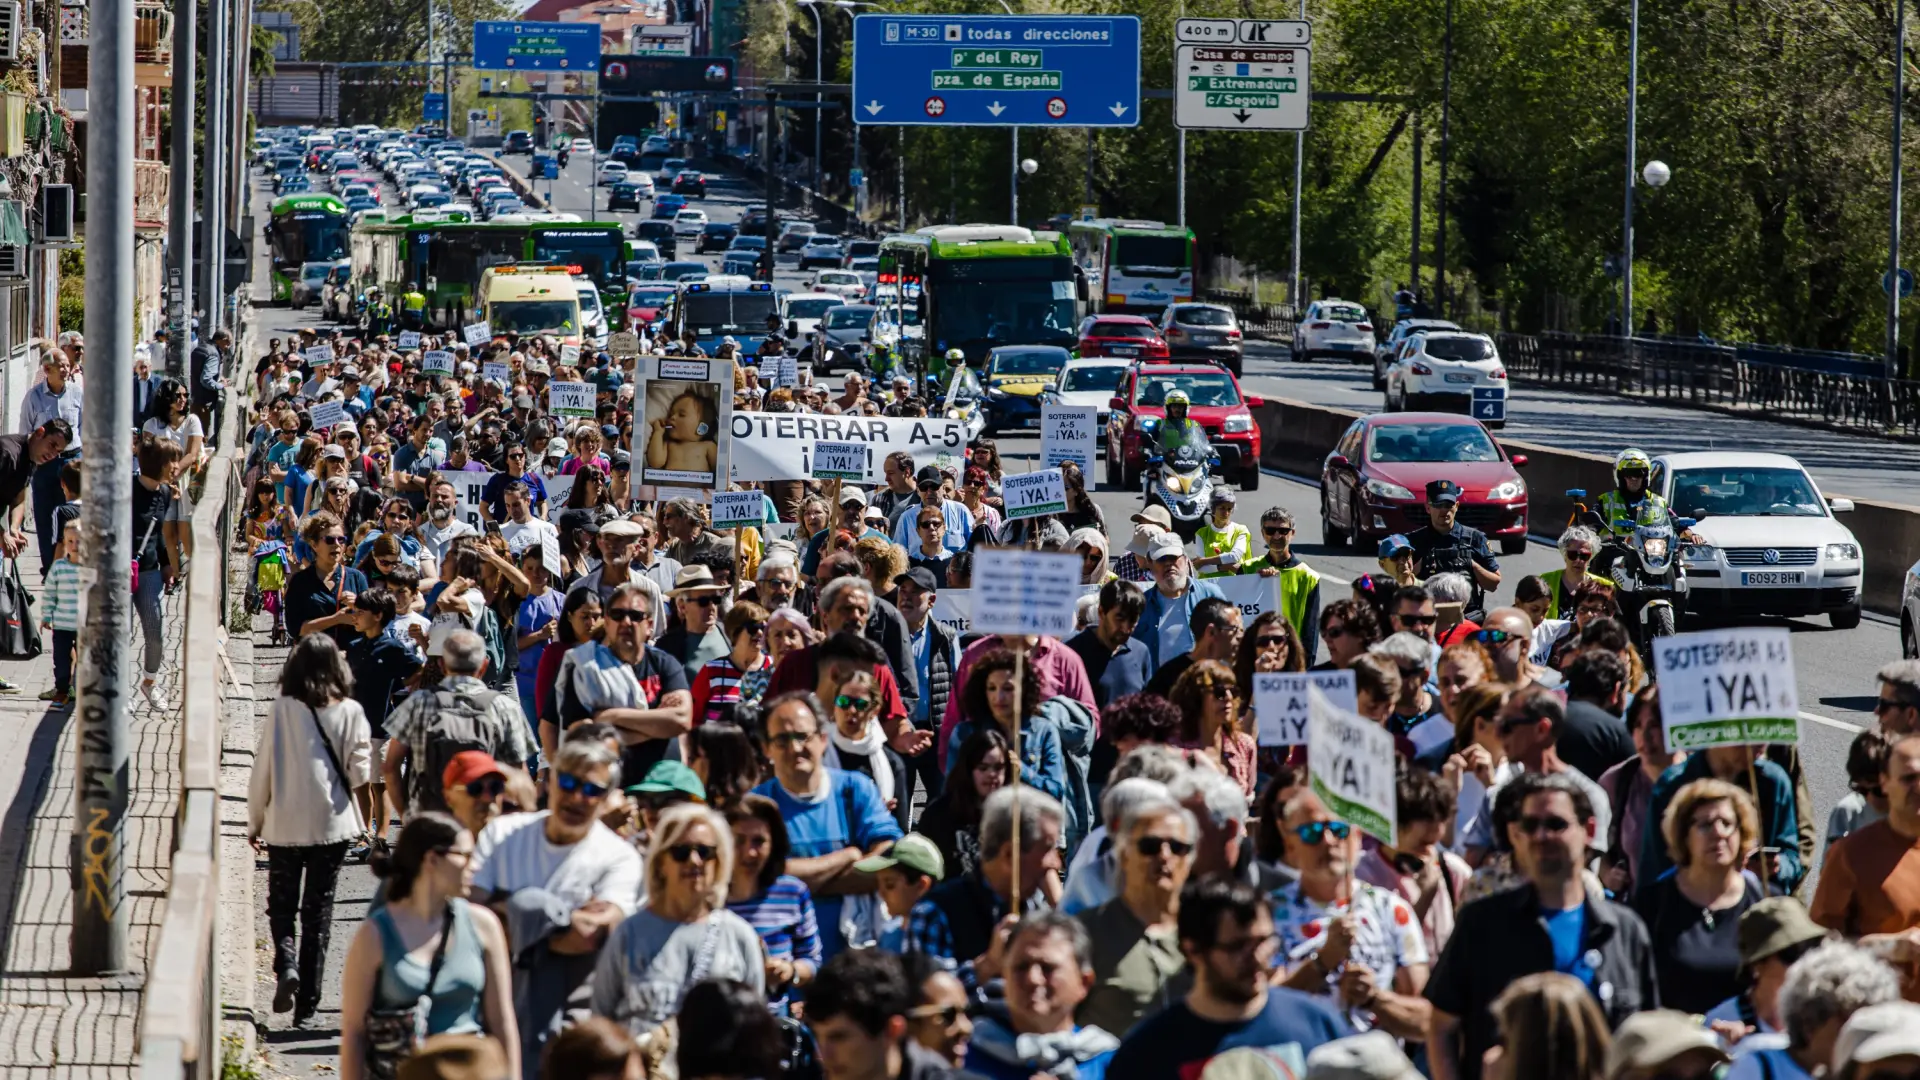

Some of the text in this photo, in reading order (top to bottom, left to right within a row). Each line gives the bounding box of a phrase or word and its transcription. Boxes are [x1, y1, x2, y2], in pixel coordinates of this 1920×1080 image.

[907, 28, 1109, 41] M-30 todas direcciones
[1185, 26, 1228, 36] 400 m
[1296, 28, 1303, 38] 3
[976, 51, 1001, 64] del
[1011, 52, 1039, 66] Rey
[1194, 49, 1293, 62] Casa de campo
[934, 73, 1059, 88] pza. de España
[1209, 78, 1297, 91] Extremadura
[1207, 94, 1278, 108] c/Segovia
[429, 359, 447, 370] ¡YA!
[552, 384, 595, 395] SOTERRAR A-5
[1485, 390, 1493, 398] 4
[562, 394, 585, 408] ¡YA!
[1482, 403, 1495, 416] 4
[732, 414, 961, 448] OTERRAR A-5
[1059, 421, 1075, 429] A-5
[1056, 430, 1079, 441] ¡YA!
[816, 444, 865, 455] SOTERRAR A-5
[826, 455, 852, 470] ¡YA!
[1005, 473, 1060, 489] SOTERRAR A-5
[714, 493, 762, 504] SOTERRAR A-5
[1020, 486, 1050, 505] ¡YA!
[726, 504, 751, 519] ¡YA!
[1009, 503, 1065, 517] Colonia Lourdes
[1749, 573, 1778, 584] 6092
[1663, 639, 1760, 671] SOTERRAR
[1703, 673, 1771, 714] ¡YA!
[1287, 696, 1307, 712] A-
[1280, 717, 1307, 740] ¡Y
[1671, 724, 1740, 748] Colonia
